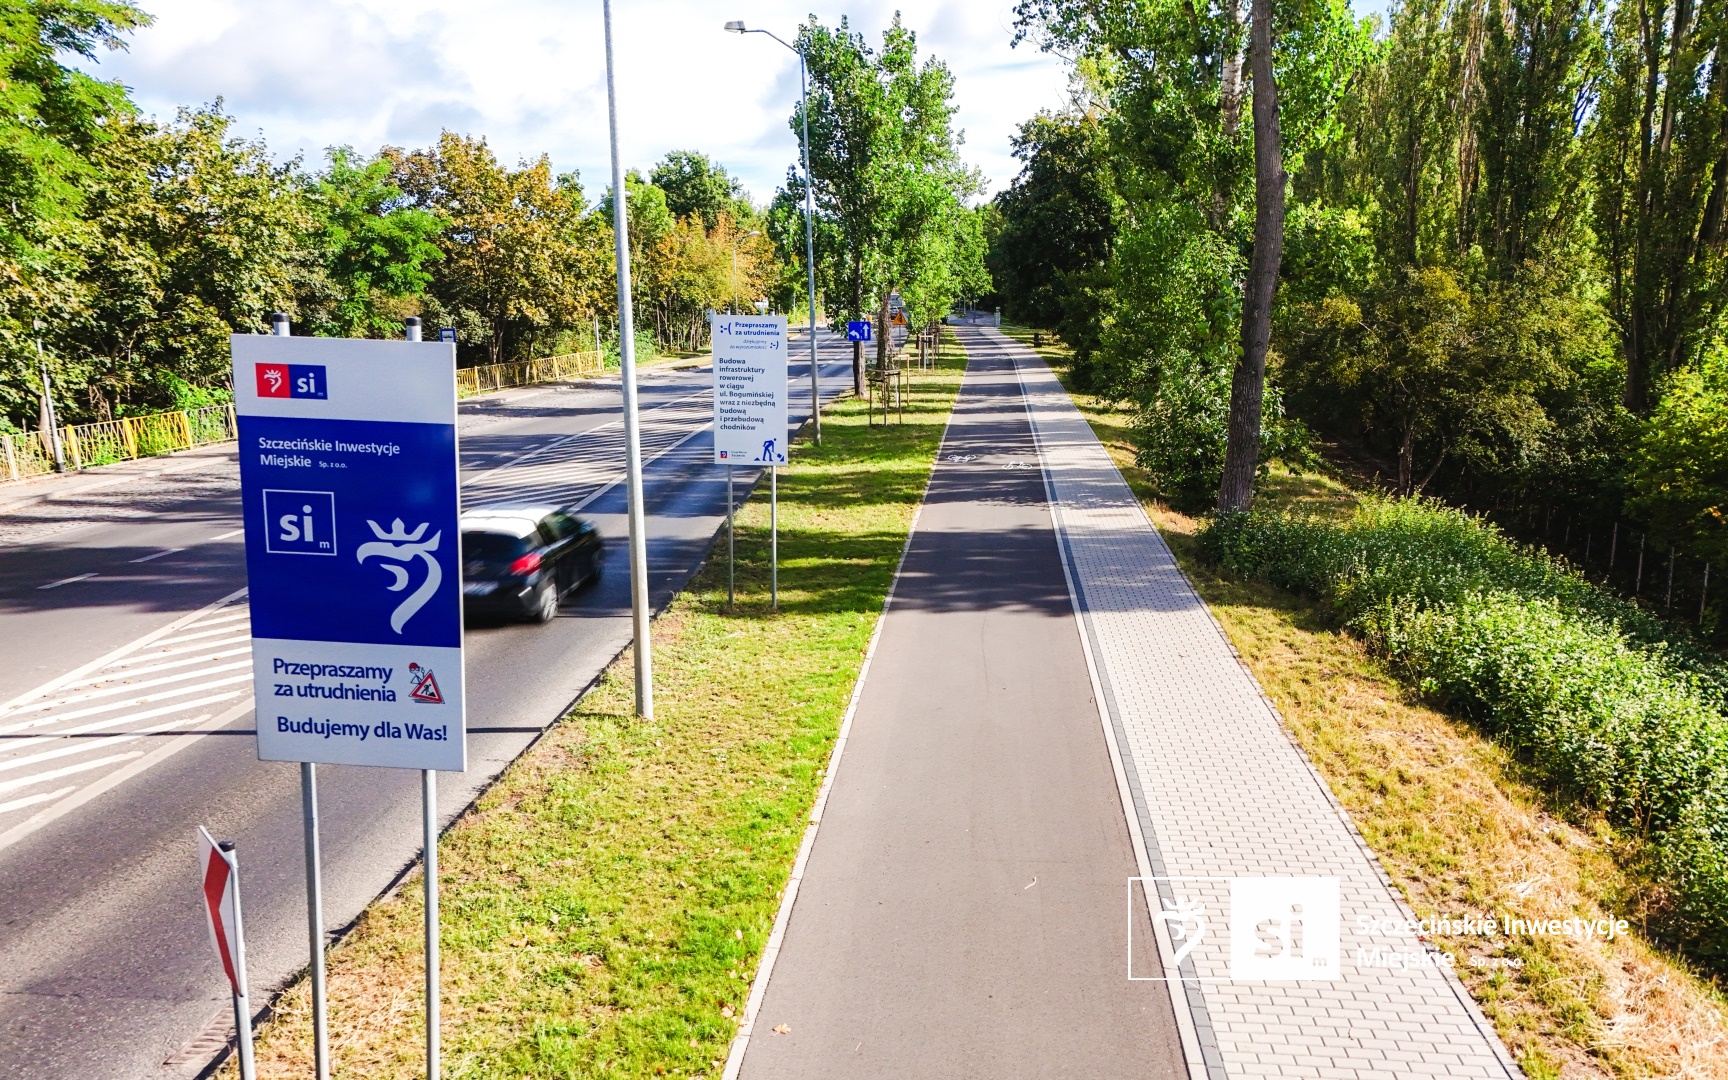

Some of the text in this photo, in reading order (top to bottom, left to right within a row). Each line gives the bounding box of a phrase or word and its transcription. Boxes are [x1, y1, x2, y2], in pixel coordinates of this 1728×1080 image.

[735, 321, 778, 329] Przepraszamy
[719, 357, 746, 365] Budowa
[719, 366, 765, 375] infrastruktury
[297, 372, 316, 394] si
[726, 382, 745, 390] ciągu
[729, 391, 774, 399] Bogumińskiej
[741, 399, 776, 408] niezbędną
[720, 407, 747, 415] budową
[723, 416, 765, 424] przebudową
[258, 437, 400, 456] Szczecińskie Inwestycje
[260, 454, 312, 469] Miejskie
[318, 460, 330, 469] Sp.
[279, 504, 330, 549] si m
[273, 657, 394, 684] Przepraszamy
[273, 682, 397, 702] za utrudnienia
[276, 716, 448, 741] Budujemy dla Was!
